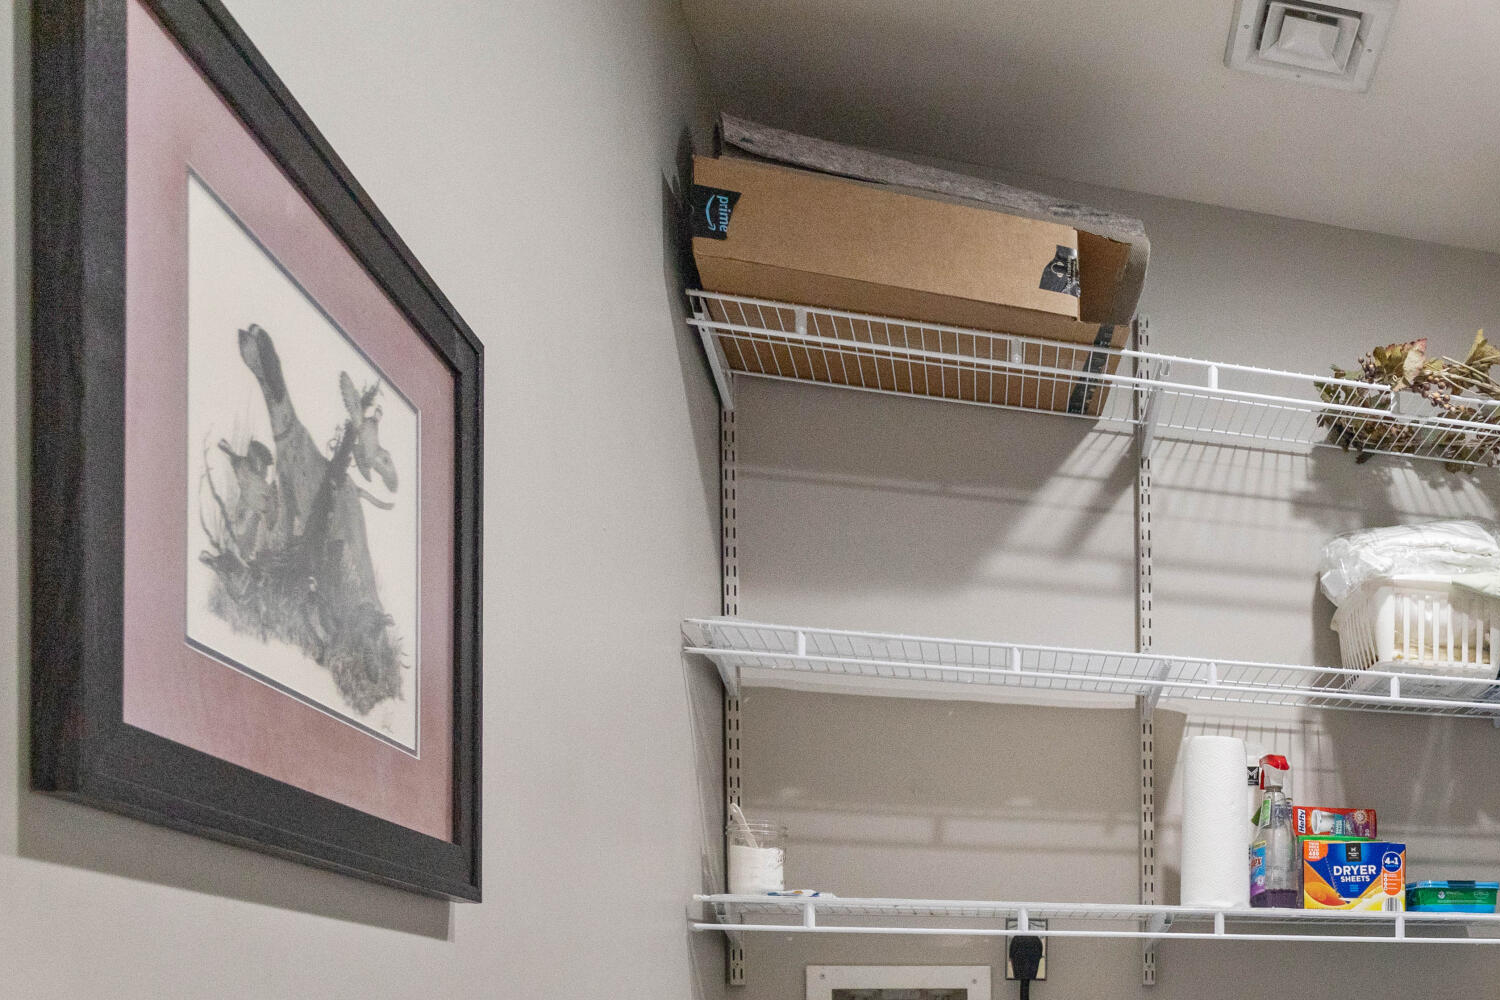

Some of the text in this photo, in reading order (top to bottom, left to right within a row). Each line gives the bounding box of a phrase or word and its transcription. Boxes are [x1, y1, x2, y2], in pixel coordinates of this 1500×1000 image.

[716, 195, 731, 232] prime
[1298, 809, 1306, 833] Hefty
[1333, 865, 1376, 876] DRYER
